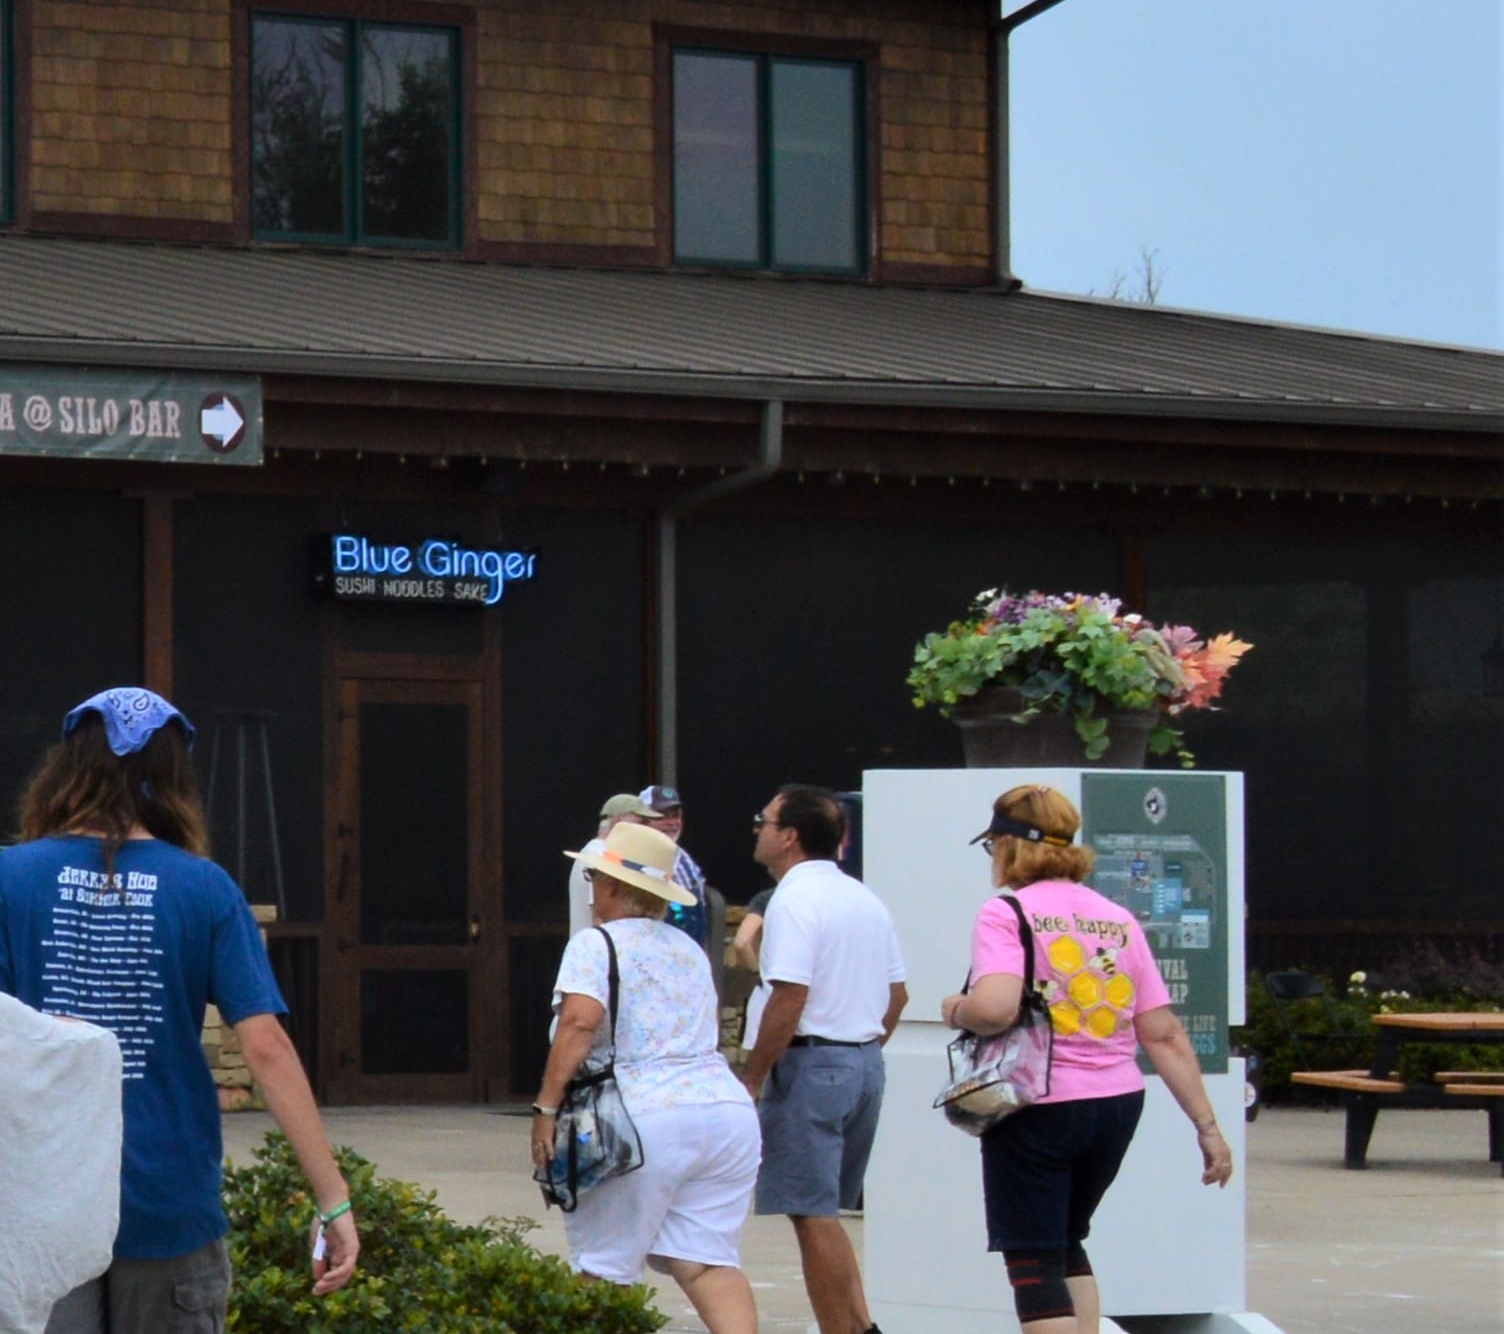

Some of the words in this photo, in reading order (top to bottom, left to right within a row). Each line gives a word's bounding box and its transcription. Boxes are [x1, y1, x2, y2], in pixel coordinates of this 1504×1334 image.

[23, 395, 52, 431] @
[59, 395, 120, 436] SILO
[128, 398, 182, 438] BAR
[335, 534, 413, 574] Blue
[424, 540, 537, 606] Ginger
[335, 576, 376, 594] SUSHI
[383, 579, 445, 599] NOODLES
[453, 582, 489, 602] SAKE
[1032, 912, 1069, 933] bee
[1072, 912, 1131, 949] happy
